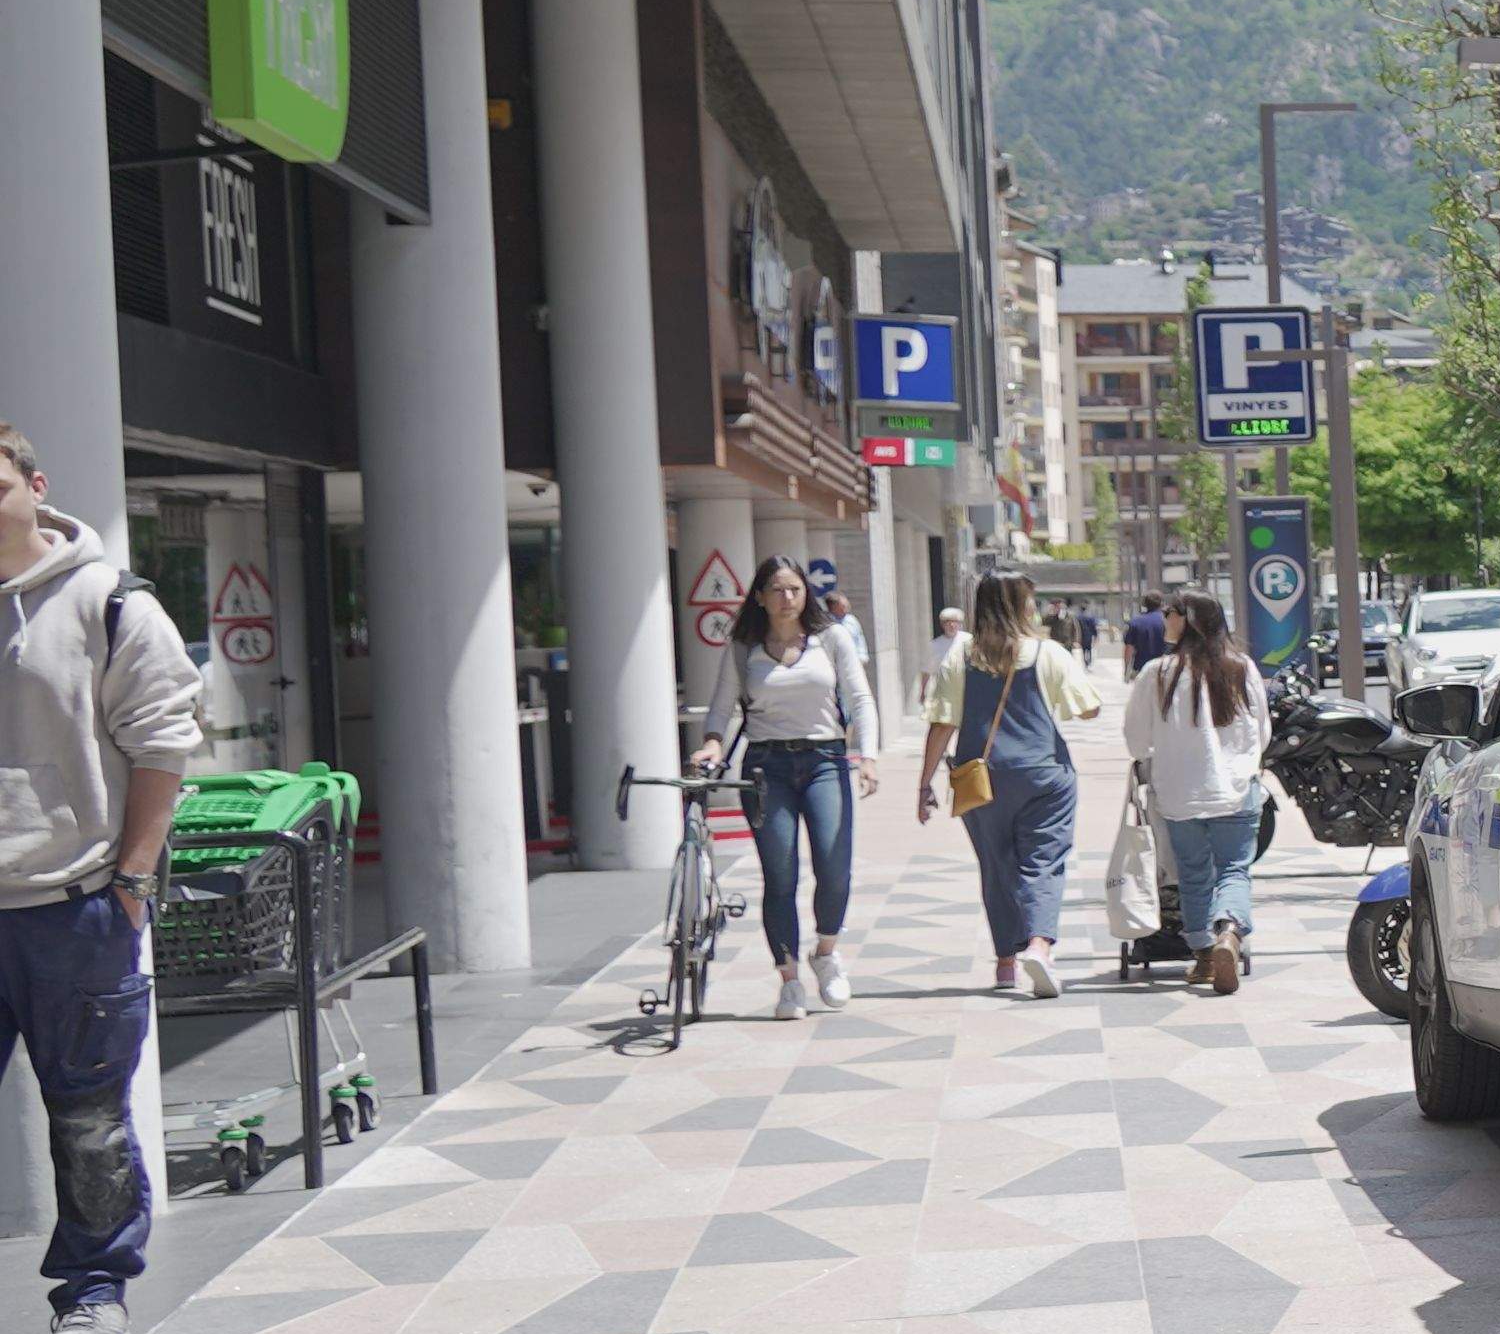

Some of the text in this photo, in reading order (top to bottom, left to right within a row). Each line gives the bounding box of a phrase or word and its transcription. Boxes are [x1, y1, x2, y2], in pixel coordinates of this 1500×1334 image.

[198, 156, 261, 306] FRESH
[880, 326, 929, 397] P
[1220, 322, 1285, 389] P
[1224, 400, 1290, 412] VINYES
